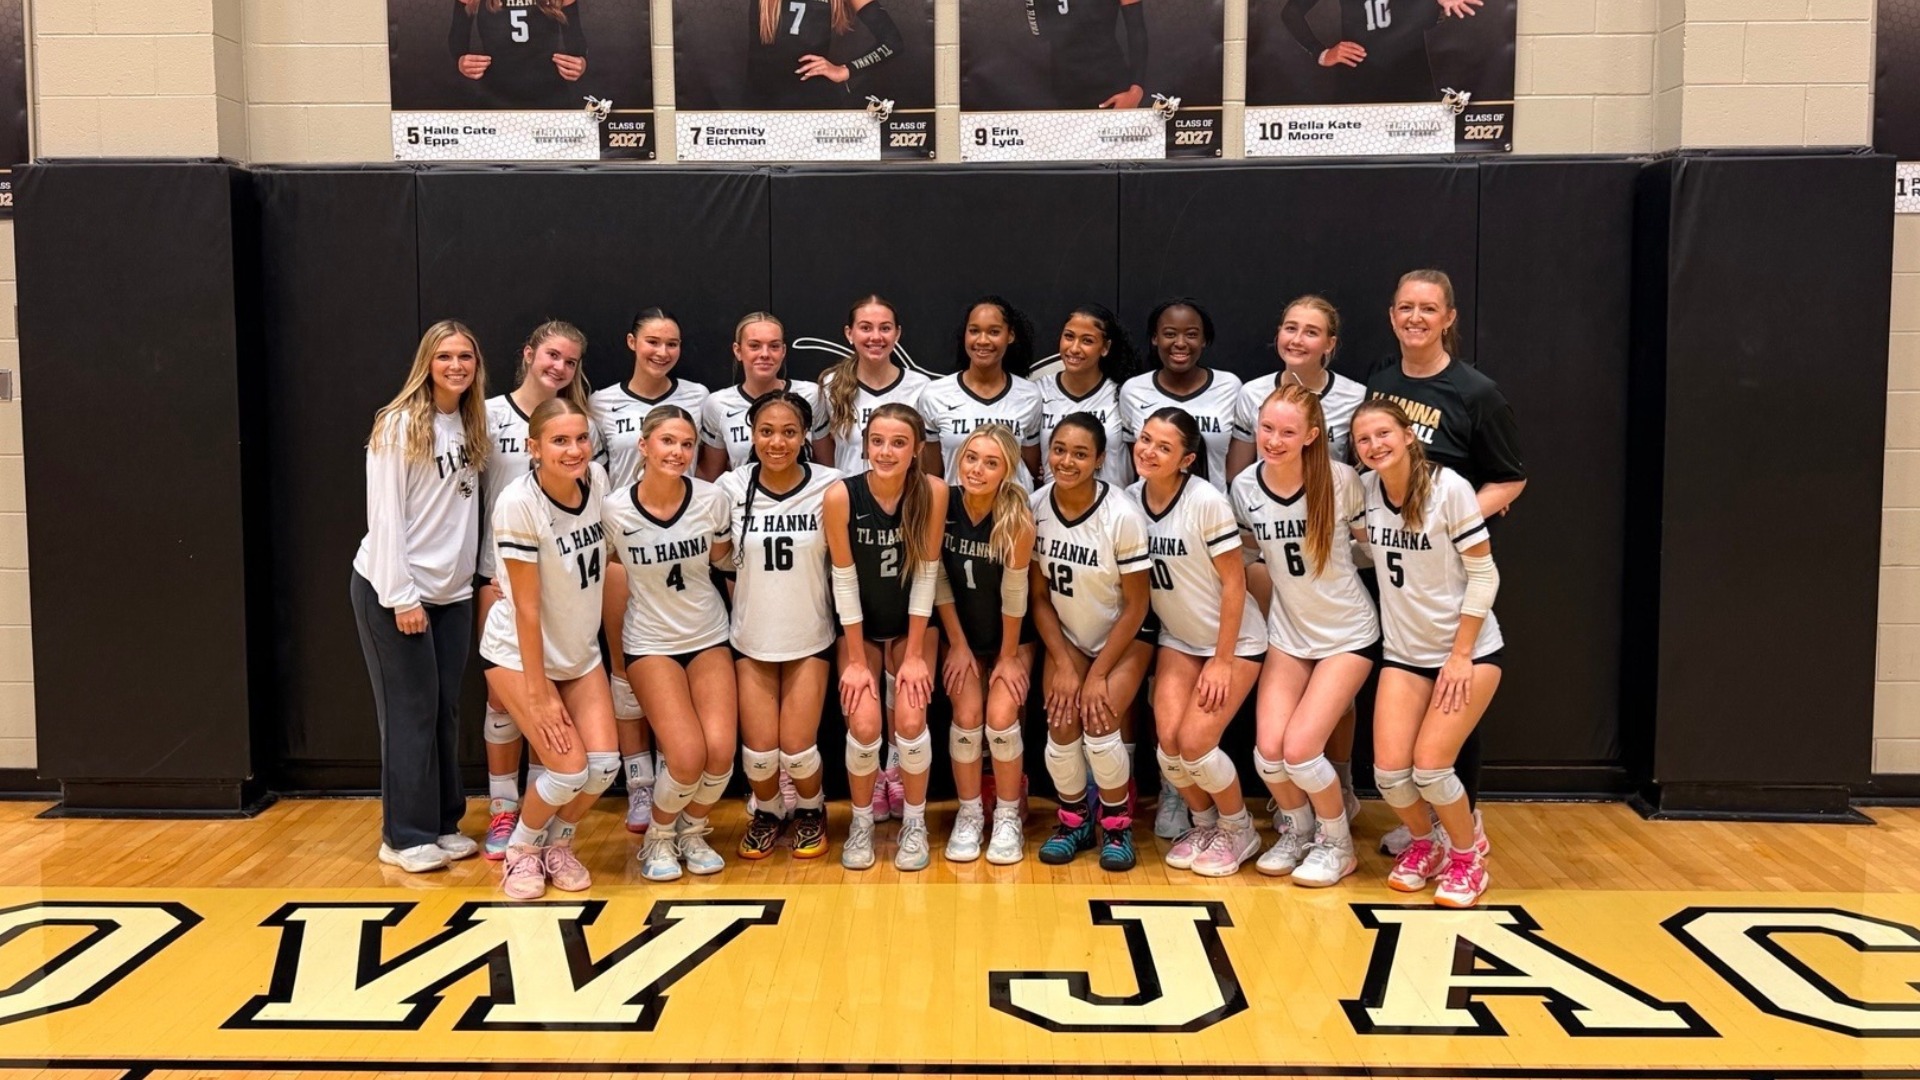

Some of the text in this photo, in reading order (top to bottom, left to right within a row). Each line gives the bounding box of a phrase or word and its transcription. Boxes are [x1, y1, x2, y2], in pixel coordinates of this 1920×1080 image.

[790, 2, 806, 35] 7
[1364, 0, 1391, 31] 10
[510, 10, 529, 42] 5
[850, 51, 882, 70] HANNA
[608, 122, 646, 130] CLASS OF
[889, 122, 927, 130] CLASS OF
[1175, 119, 1214, 128] CLASS OF
[1288, 120, 1362, 130] Bella Kate
[1465, 112, 1505, 122] CLASS OF
[407, 127, 419, 145] 5
[423, 126, 497, 135] Halle Cate
[690, 127, 702, 145] 7
[706, 126, 765, 137] Serenity
[975, 128, 987, 146] 9
[992, 127, 1019, 136] Erin
[1175, 131, 1213, 145] 2027
[1259, 123, 1282, 140] 10
[1288, 131, 1334, 141] Moore
[1464, 125, 1504, 140] 2027
[424, 137, 459, 146] Epps
[609, 133, 646, 147] 2027
[706, 137, 766, 146] Eichman
[890, 133, 927, 147] 2027
[992, 137, 1025, 147] Lyda
[615, 418, 635, 434] TL
[730, 425, 749, 443] TL
[952, 418, 970, 434] TL
[499, 438, 519, 453] TL
[763, 514, 818, 532] HANNA
[1253, 519, 1306, 541] TL HAN
[857, 527, 874, 545] TL
[944, 532, 956, 552] TL
[1381, 527, 1432, 551] HANNA
[628, 535, 708, 565] TL HANNA
[763, 536, 793, 571] 16
[1049, 539, 1099, 567] HANNA
[1284, 541, 1306, 577] 6
[577, 547, 601, 590] 14
[880, 547, 898, 577] 2
[1386, 550, 1405, 588] 5
[666, 563, 686, 592] 4
[963, 559, 977, 589] 1
[1048, 561, 1074, 598] 12
